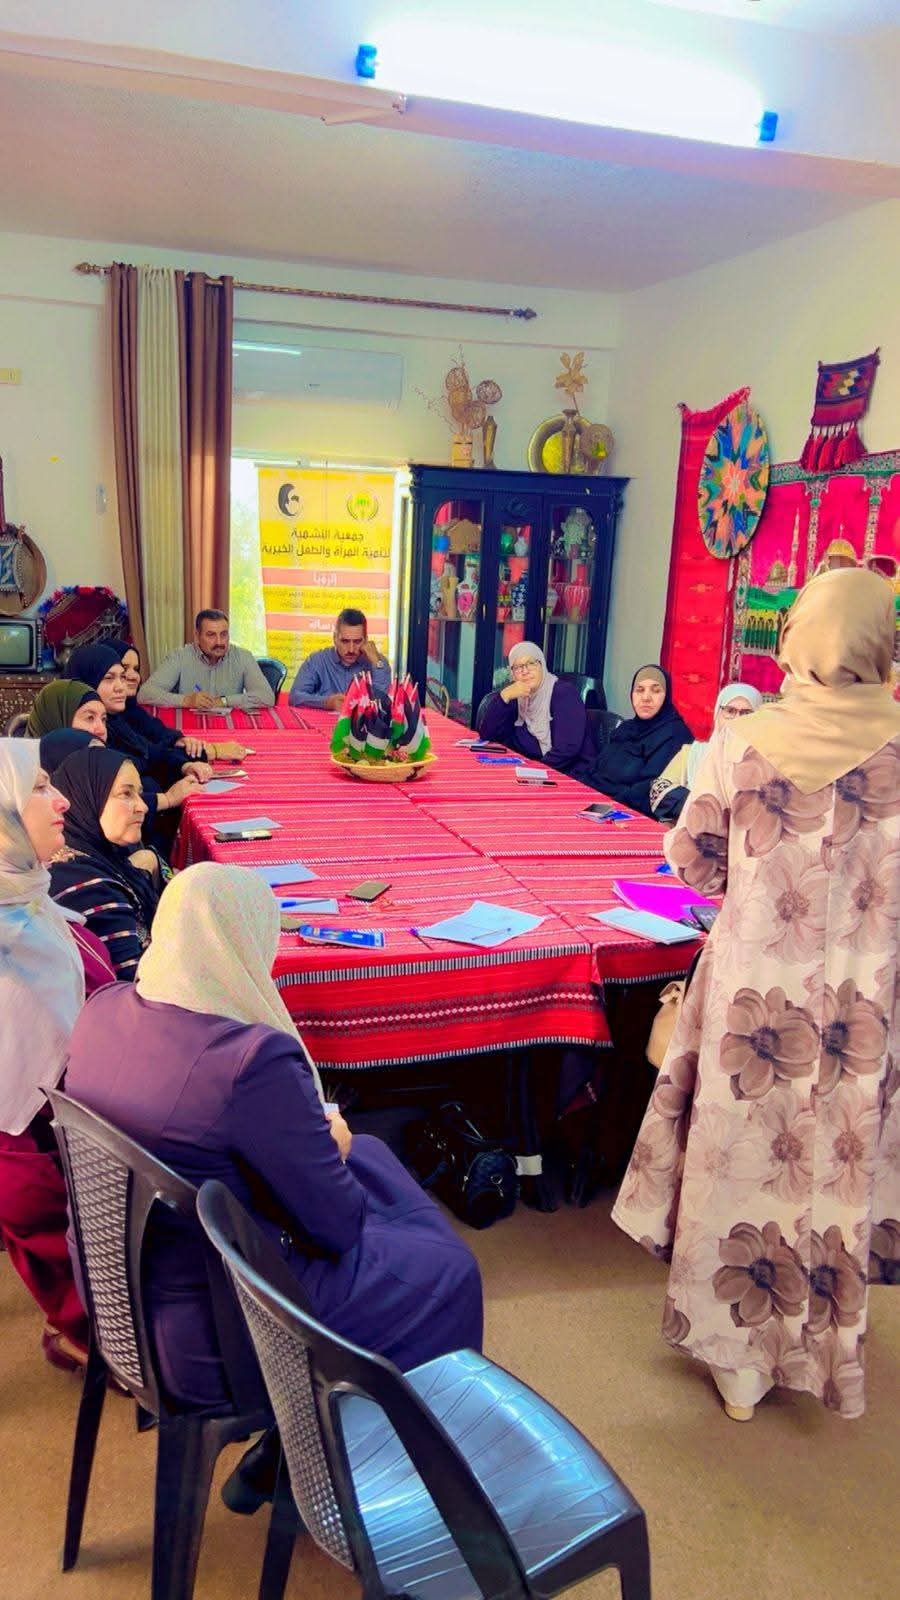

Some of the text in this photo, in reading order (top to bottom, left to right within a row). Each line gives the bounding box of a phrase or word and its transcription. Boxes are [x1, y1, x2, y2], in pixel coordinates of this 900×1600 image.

[334, 529, 365, 542] جمعية
[261, 543, 294, 555] الخيرية
[296, 544, 331, 557] والطفل
[309, 618, 335, 630] رسالة
